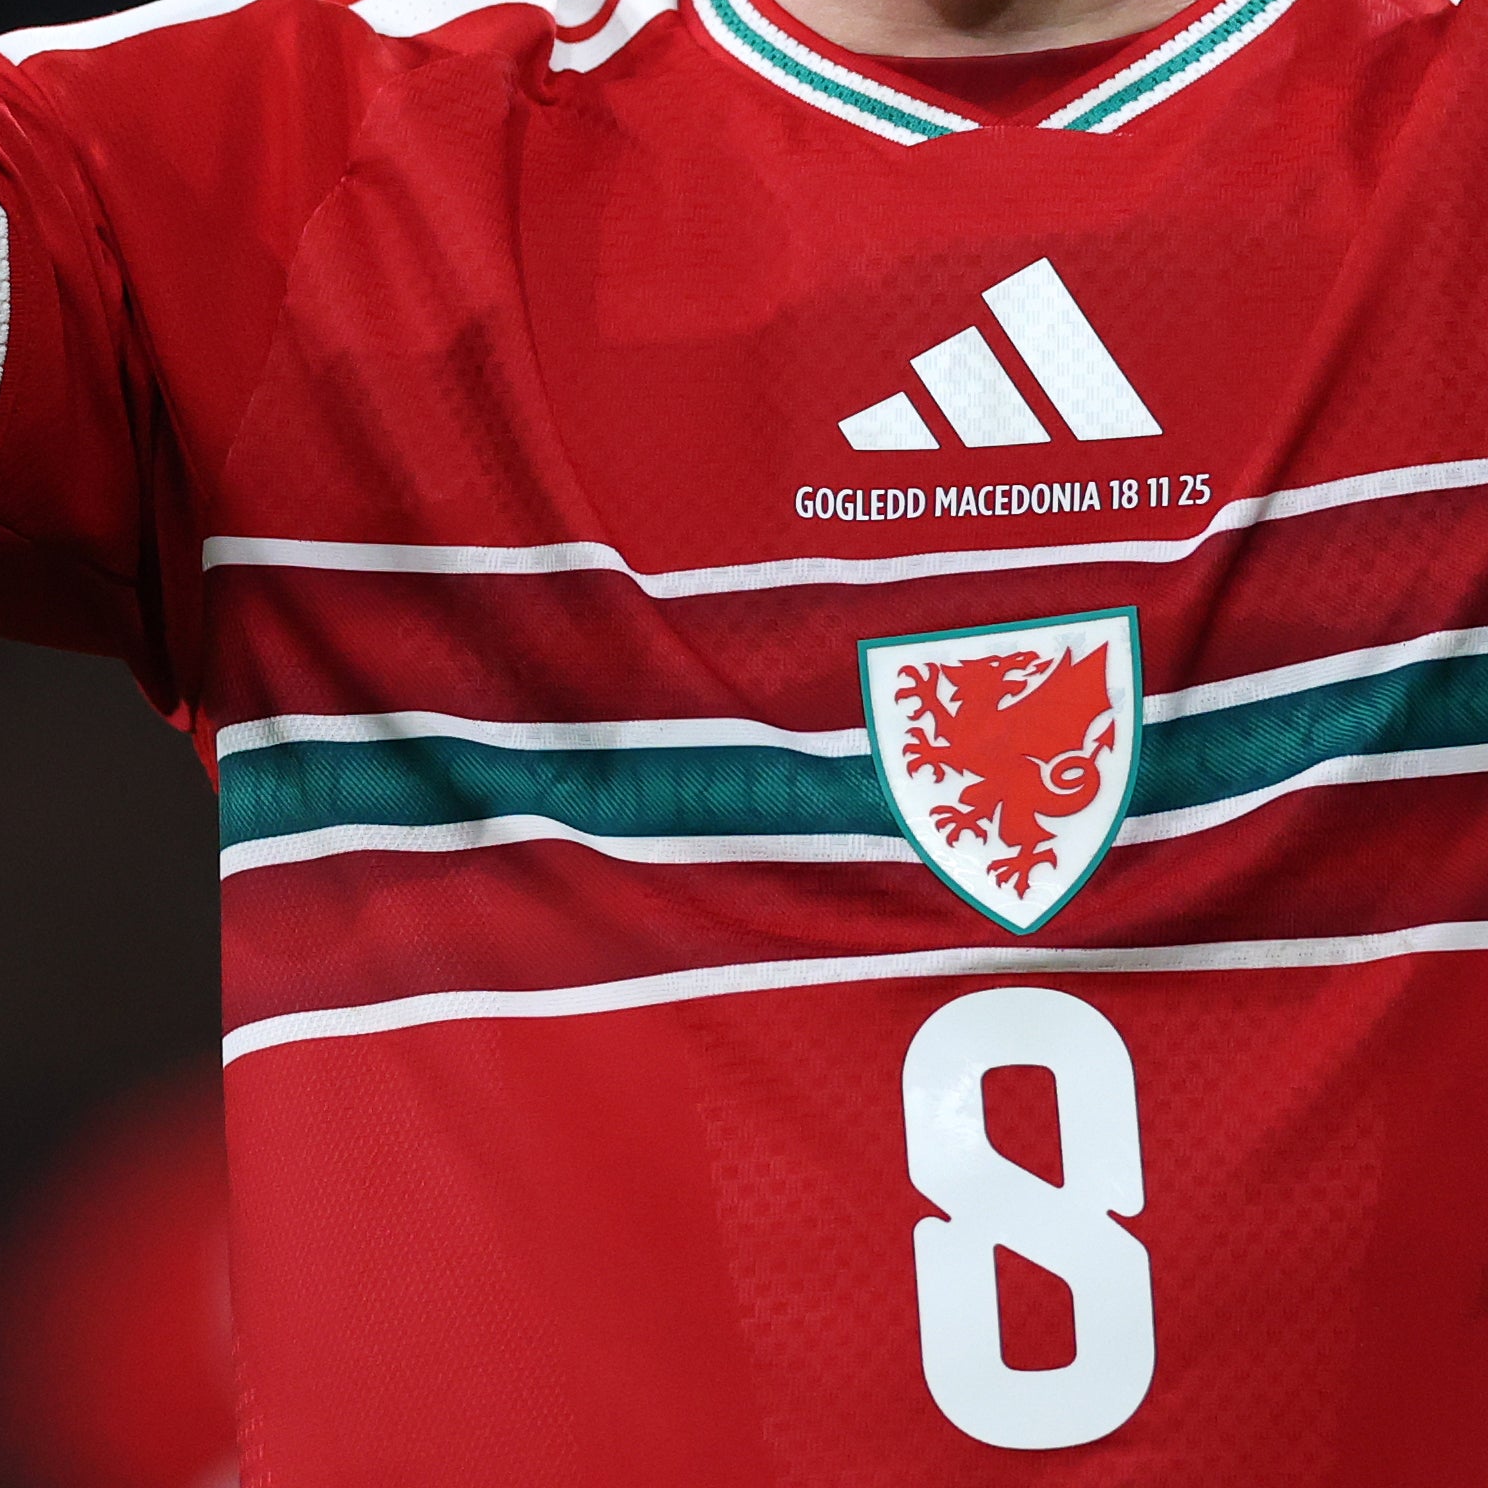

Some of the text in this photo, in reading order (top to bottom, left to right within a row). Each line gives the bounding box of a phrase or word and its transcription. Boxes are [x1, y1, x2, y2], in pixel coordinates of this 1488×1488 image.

[795, 473, 1211, 521] GOGLEDD MACEDONIA 18 11 25
[902, 986, 1156, 1450] 8
